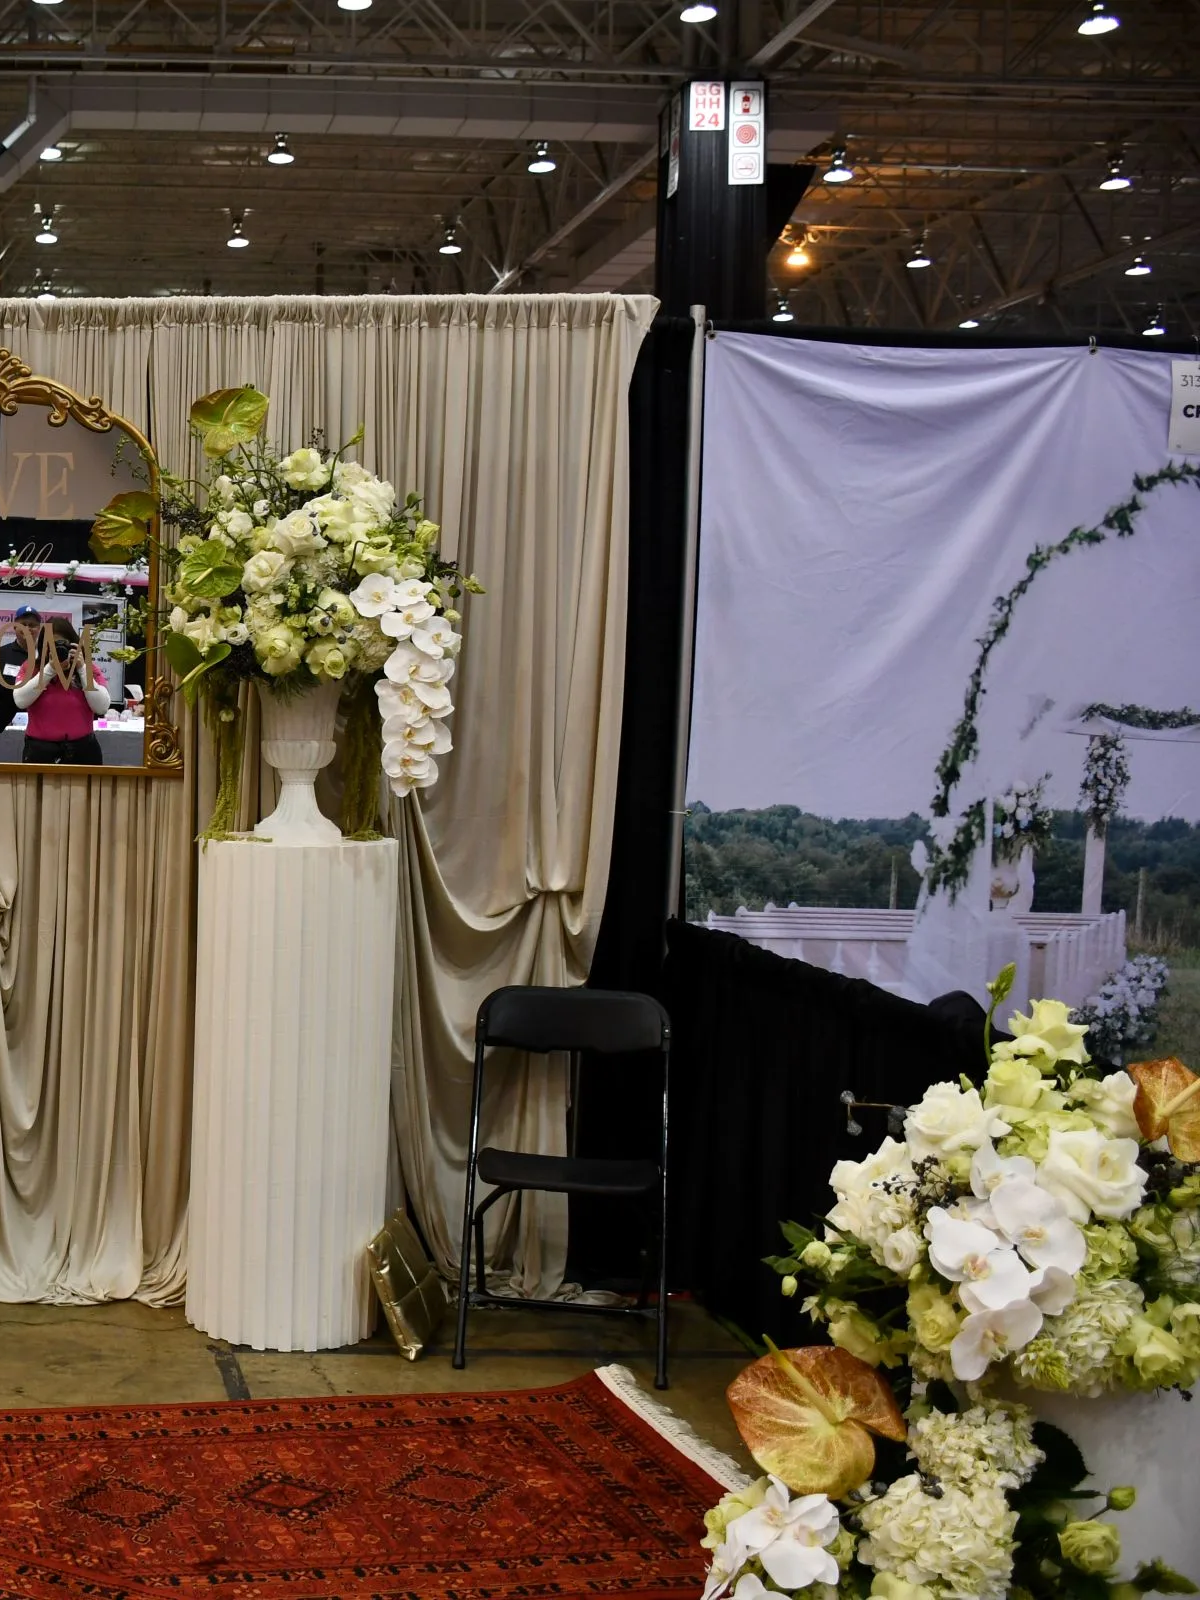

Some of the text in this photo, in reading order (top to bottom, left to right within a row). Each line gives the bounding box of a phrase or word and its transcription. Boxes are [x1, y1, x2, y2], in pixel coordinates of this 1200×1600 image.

[694, 83, 721, 96] GG
[695, 98, 721, 109] HH
[694, 113, 720, 128] 24
